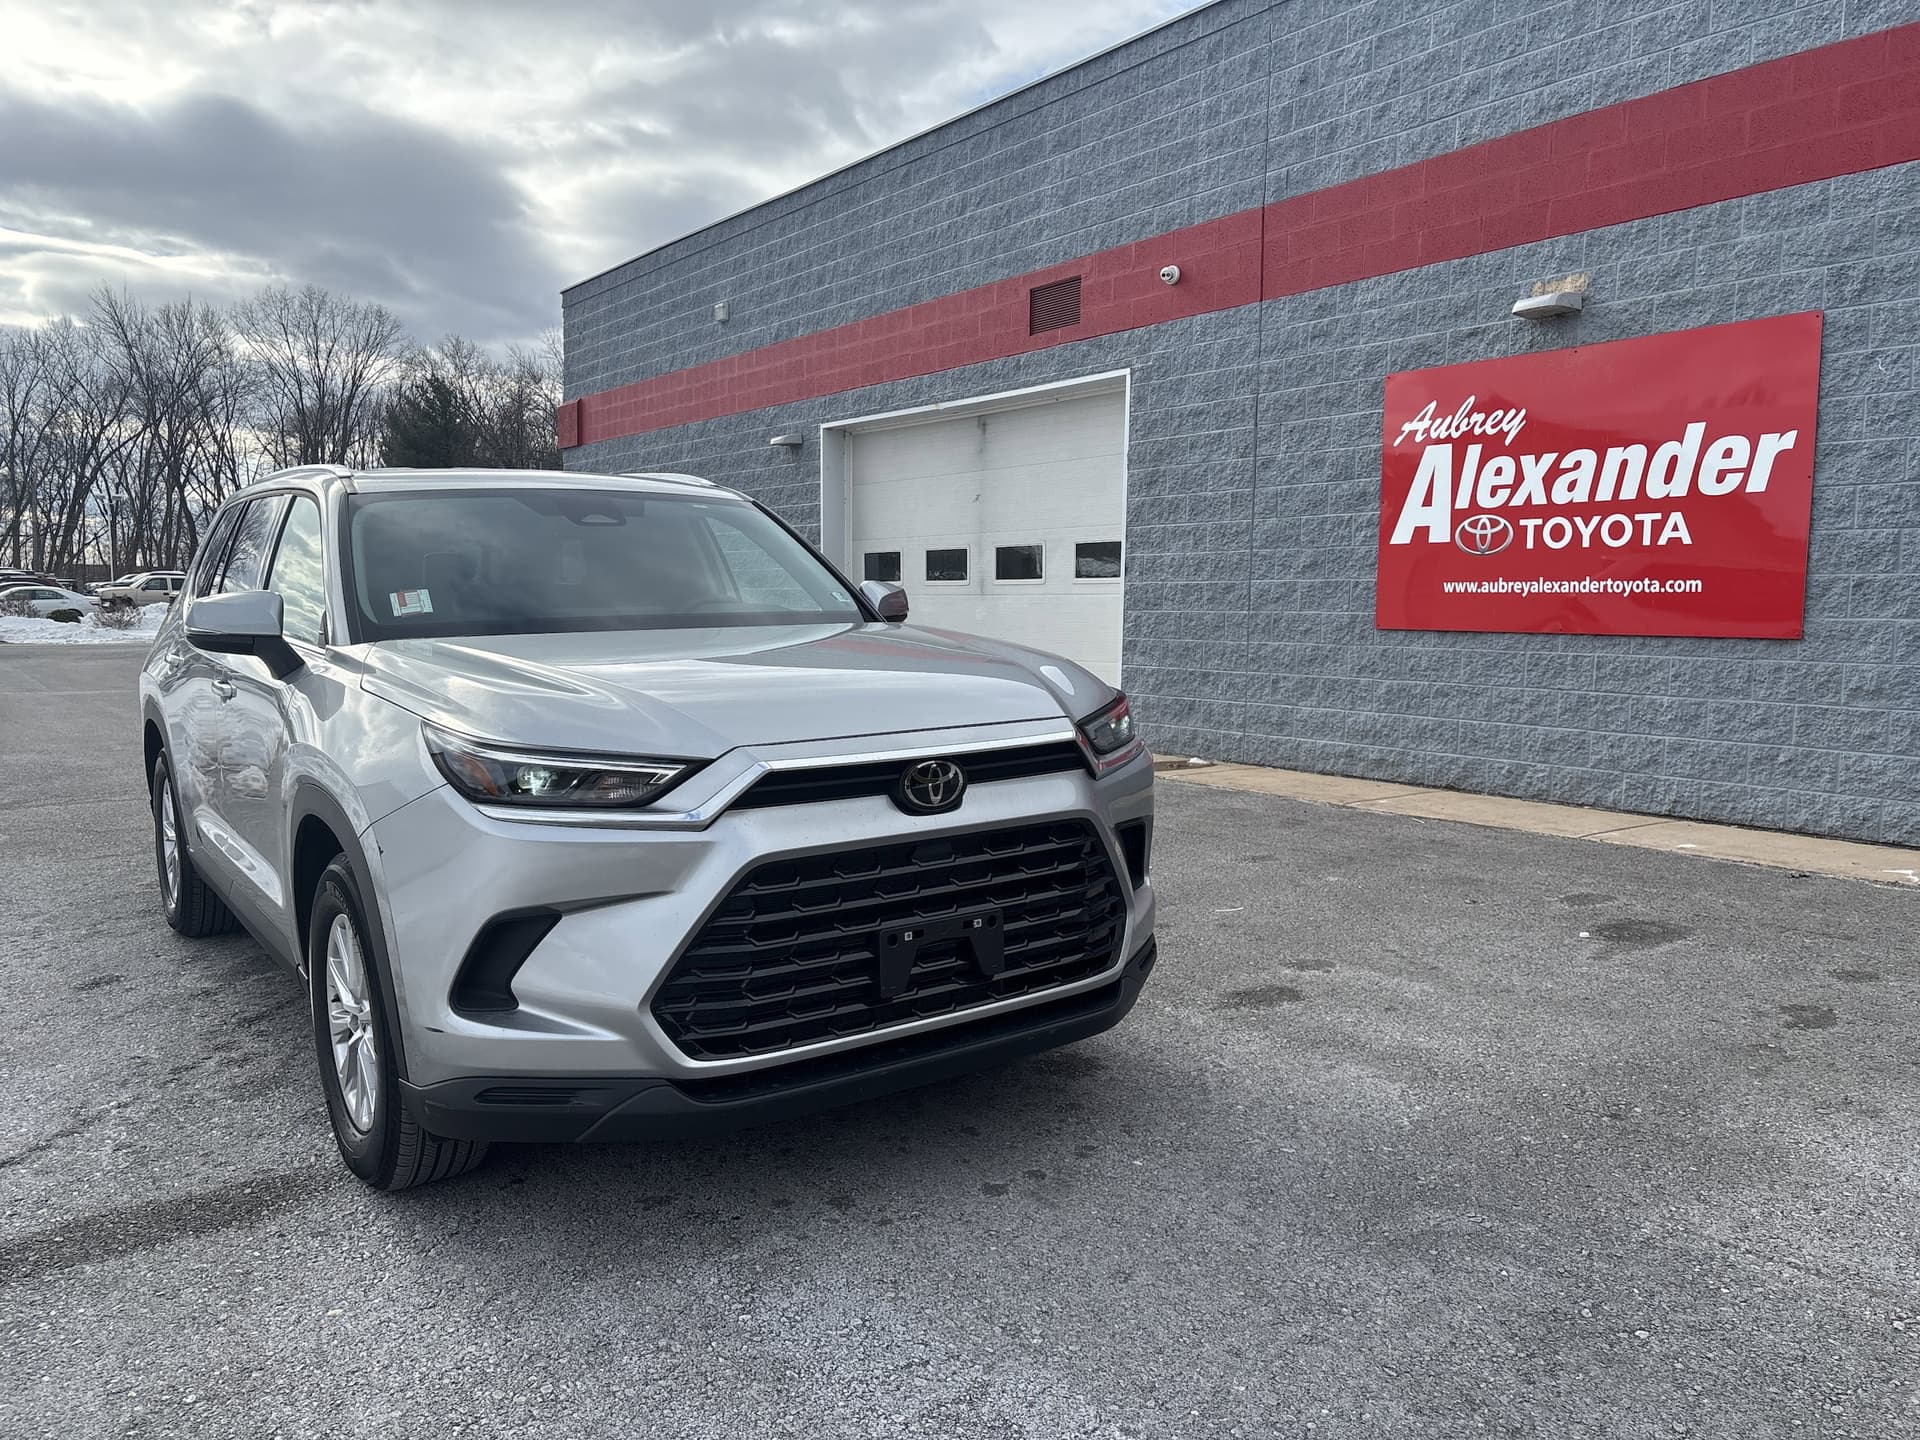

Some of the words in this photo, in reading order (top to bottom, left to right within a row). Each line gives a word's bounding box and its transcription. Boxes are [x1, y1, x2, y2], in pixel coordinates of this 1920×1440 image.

[1393, 395, 1526, 446] Aubrey
[1389, 422, 1798, 544] Alexander
[1519, 511, 1693, 549] TOYOTA
[1442, 576, 1702, 597] www.aubreyalexandertoyota.com
